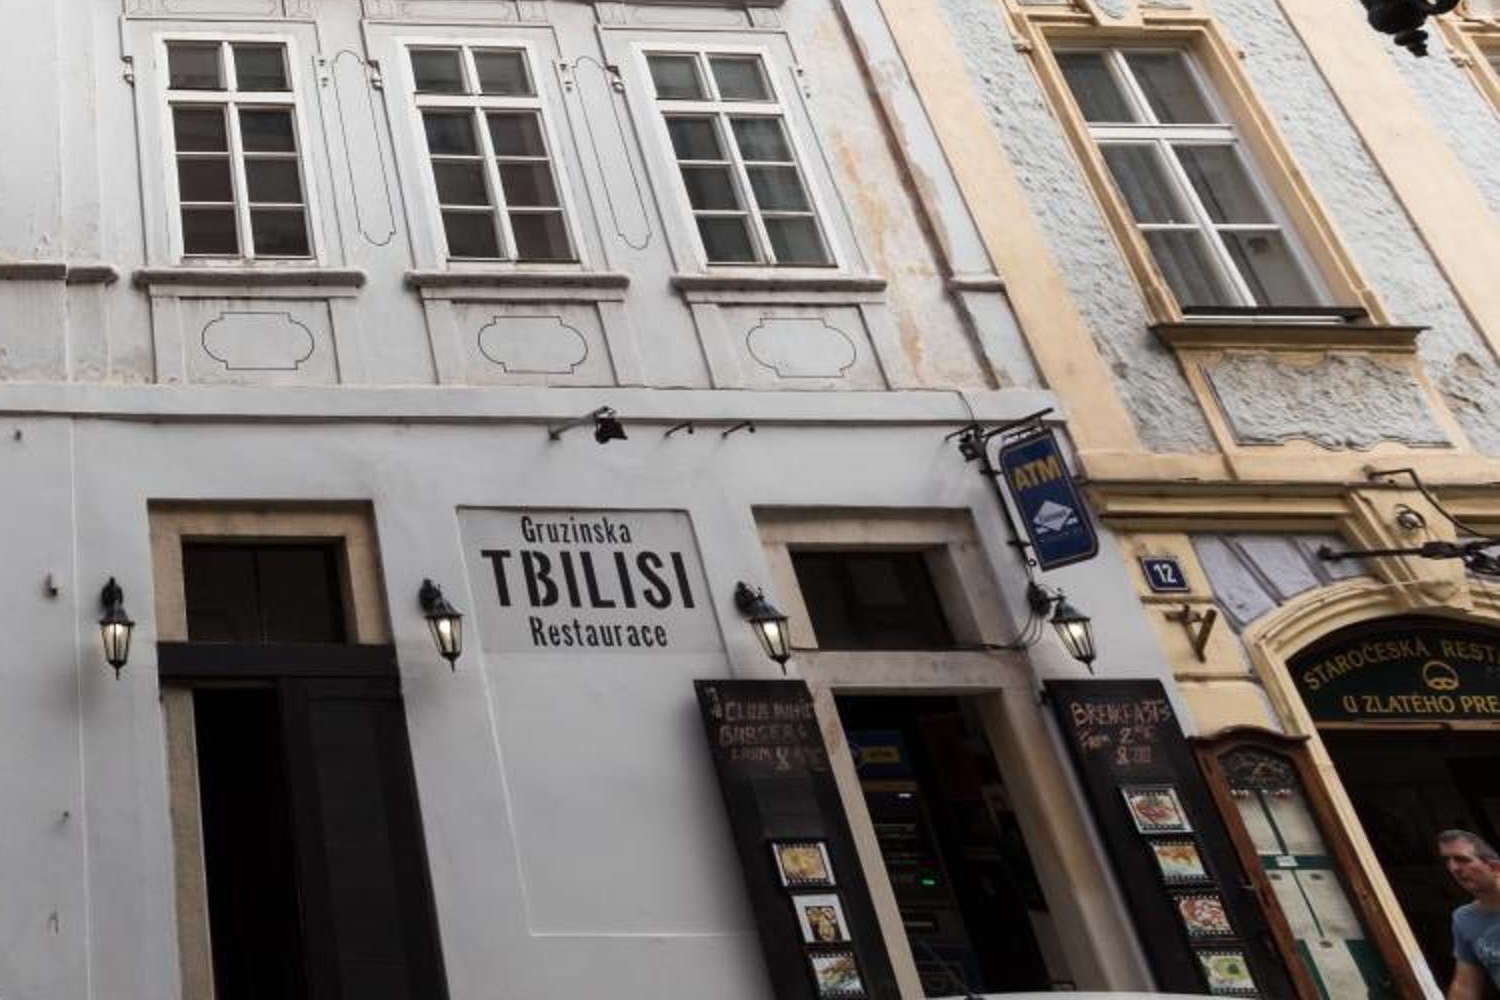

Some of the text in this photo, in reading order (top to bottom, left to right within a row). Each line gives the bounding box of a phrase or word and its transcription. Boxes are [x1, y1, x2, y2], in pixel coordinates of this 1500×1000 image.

[1013, 455, 1061, 491] ATM
[520, 515, 633, 544] Gruzinska
[480, 549, 696, 609] TBILISI
[1153, 563, 1177, 585] 12
[528, 615, 669, 648] Restaurace
[1362, 691, 1456, 713] ZLATÉHO
